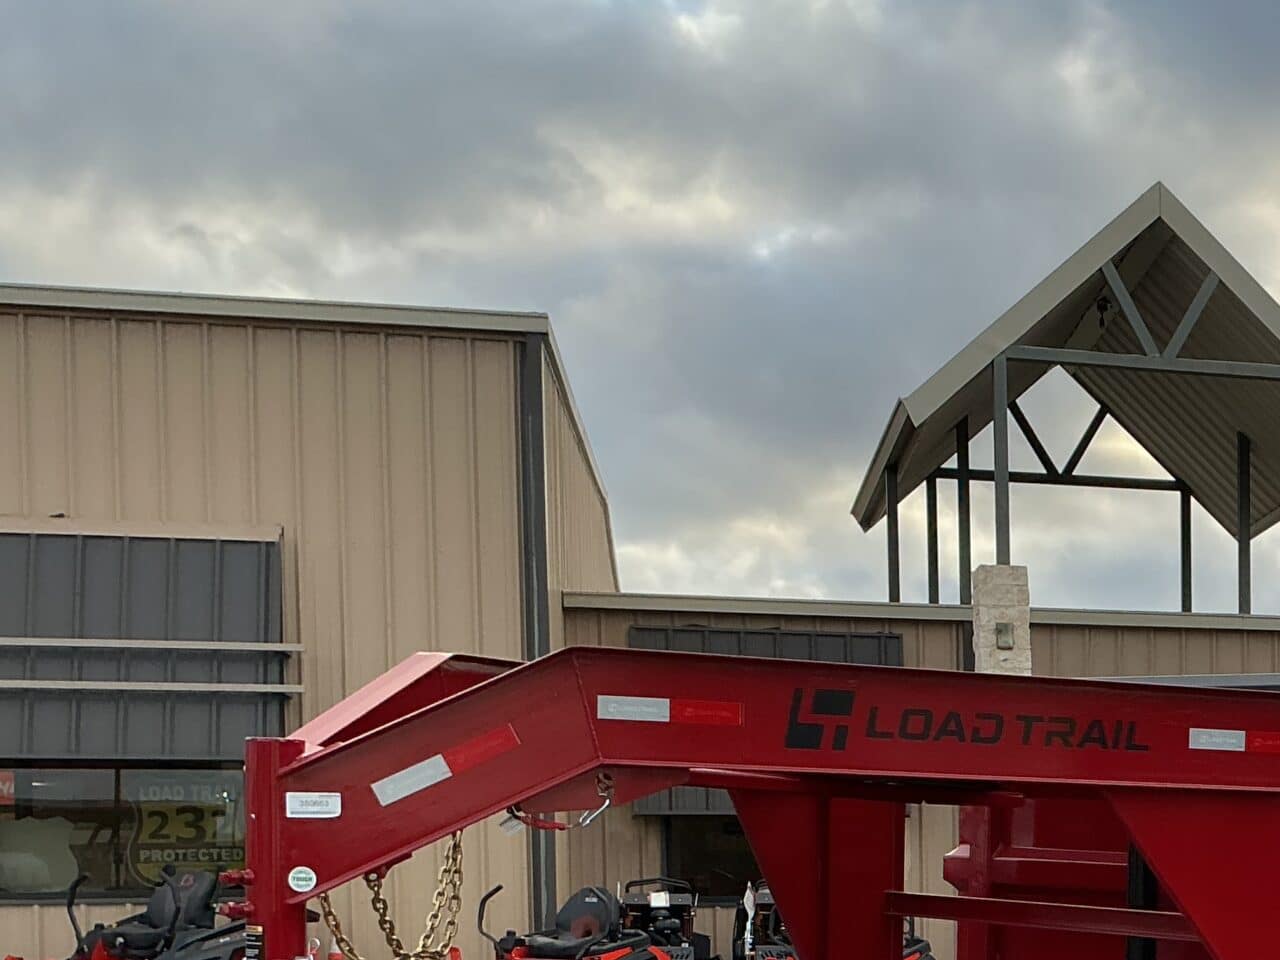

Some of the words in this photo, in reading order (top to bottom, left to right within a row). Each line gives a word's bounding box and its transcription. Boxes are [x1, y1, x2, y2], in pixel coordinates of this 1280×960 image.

[866, 706, 1006, 744] LOAD
[1016, 714, 1150, 751] TRAIL
[139, 785, 185, 801] LOAD
[140, 849, 243, 862] PROTECTED
